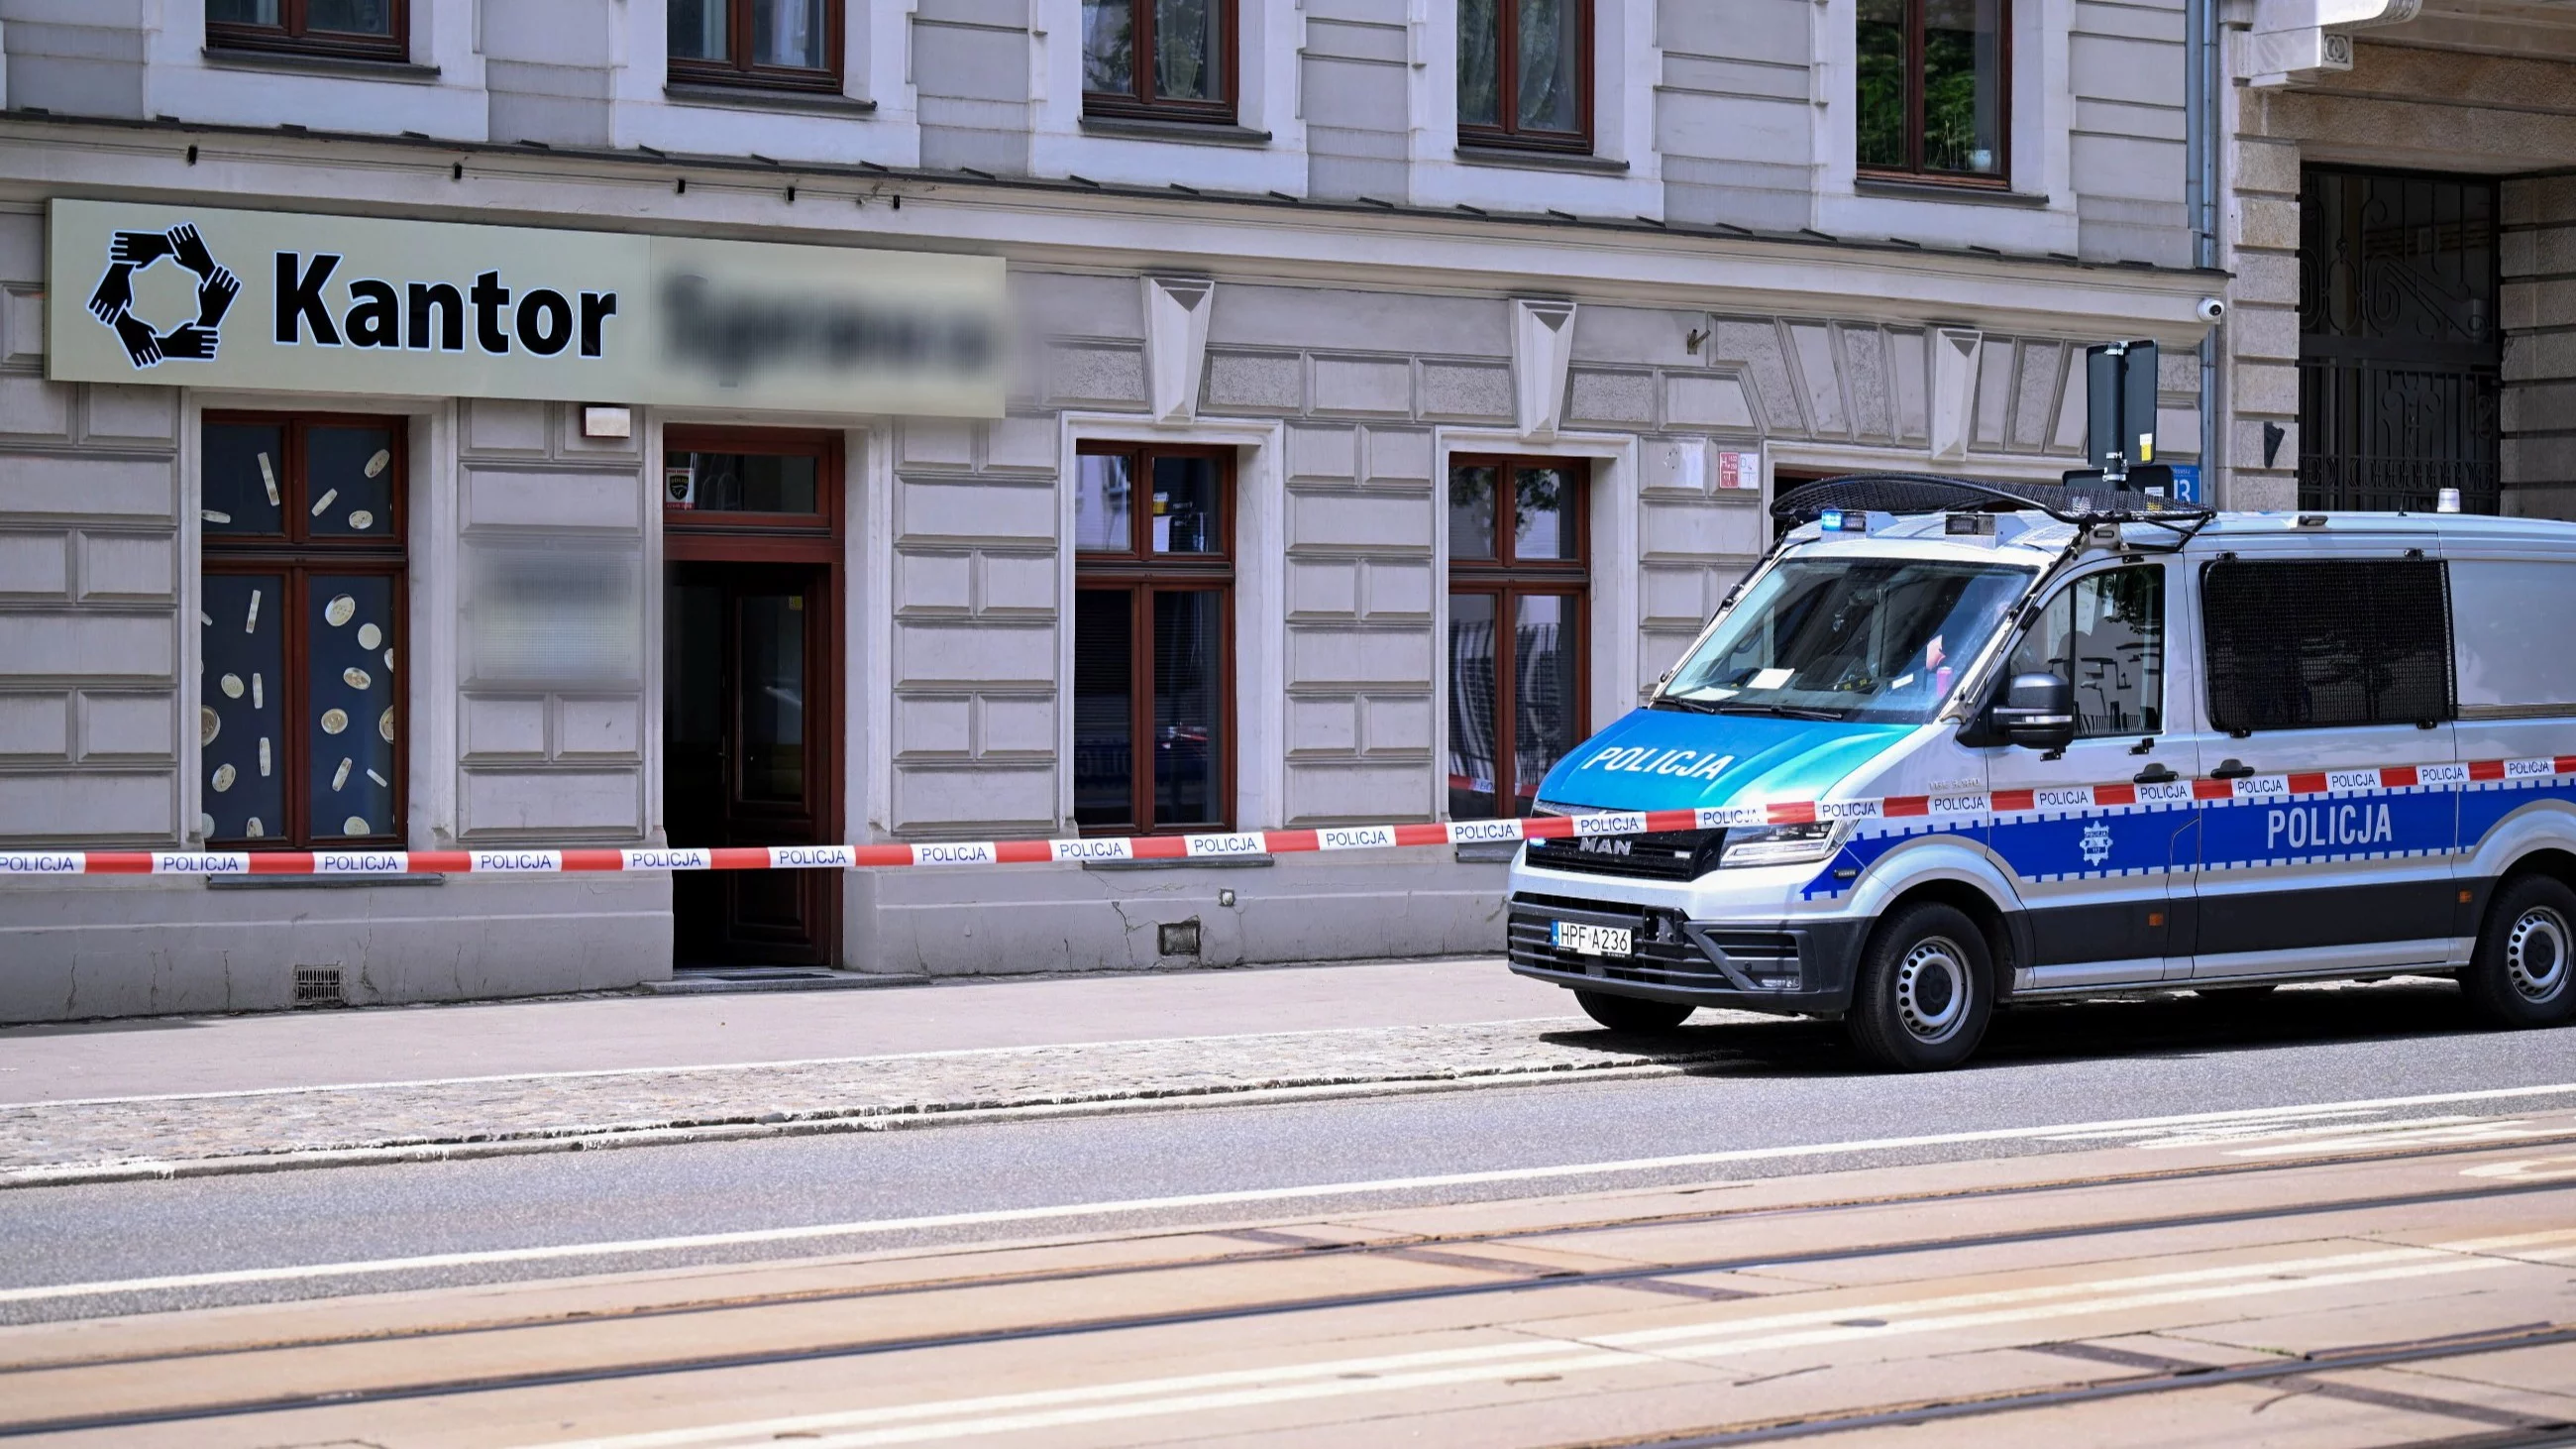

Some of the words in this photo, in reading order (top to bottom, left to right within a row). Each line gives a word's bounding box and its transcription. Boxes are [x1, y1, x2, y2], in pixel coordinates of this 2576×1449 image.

[273, 251, 618, 358] Kantor
[1581, 746, 1735, 780] POLICJA
[162, 856, 239, 872] POLICJA
[324, 855, 398, 871] POLICJA
[482, 854, 552, 870] POLICJA
[633, 852, 702, 867] POLICJA
[780, 850, 847, 865] POLICJA
[921, 847, 988, 862] POLICJA
[1060, 842, 1125, 858] POLICJA
[1195, 837, 1257, 852] POLICJA
[1327, 831, 1387, 846] POLICJA
[1455, 824, 1515, 839] POLICJA
[1580, 817, 1639, 833] POLICJA
[1822, 801, 1877, 817] POLICJA
[1934, 796, 1986, 811] POLICJA
[2039, 791, 2089, 806] POLICJA
[2140, 786, 2188, 800] POLICJA
[2237, 779, 2284, 794] POLICJA
[2331, 774, 2376, 788] POLICJA
[2421, 768, 2465, 782] POLICJA
[2509, 761, 2550, 775] POLICJA
[2267, 804, 2393, 848] POLICJA
[1578, 836, 1632, 856] MAN
[1560, 924, 1587, 947] HPF
[1592, 928, 1628, 951] A236
